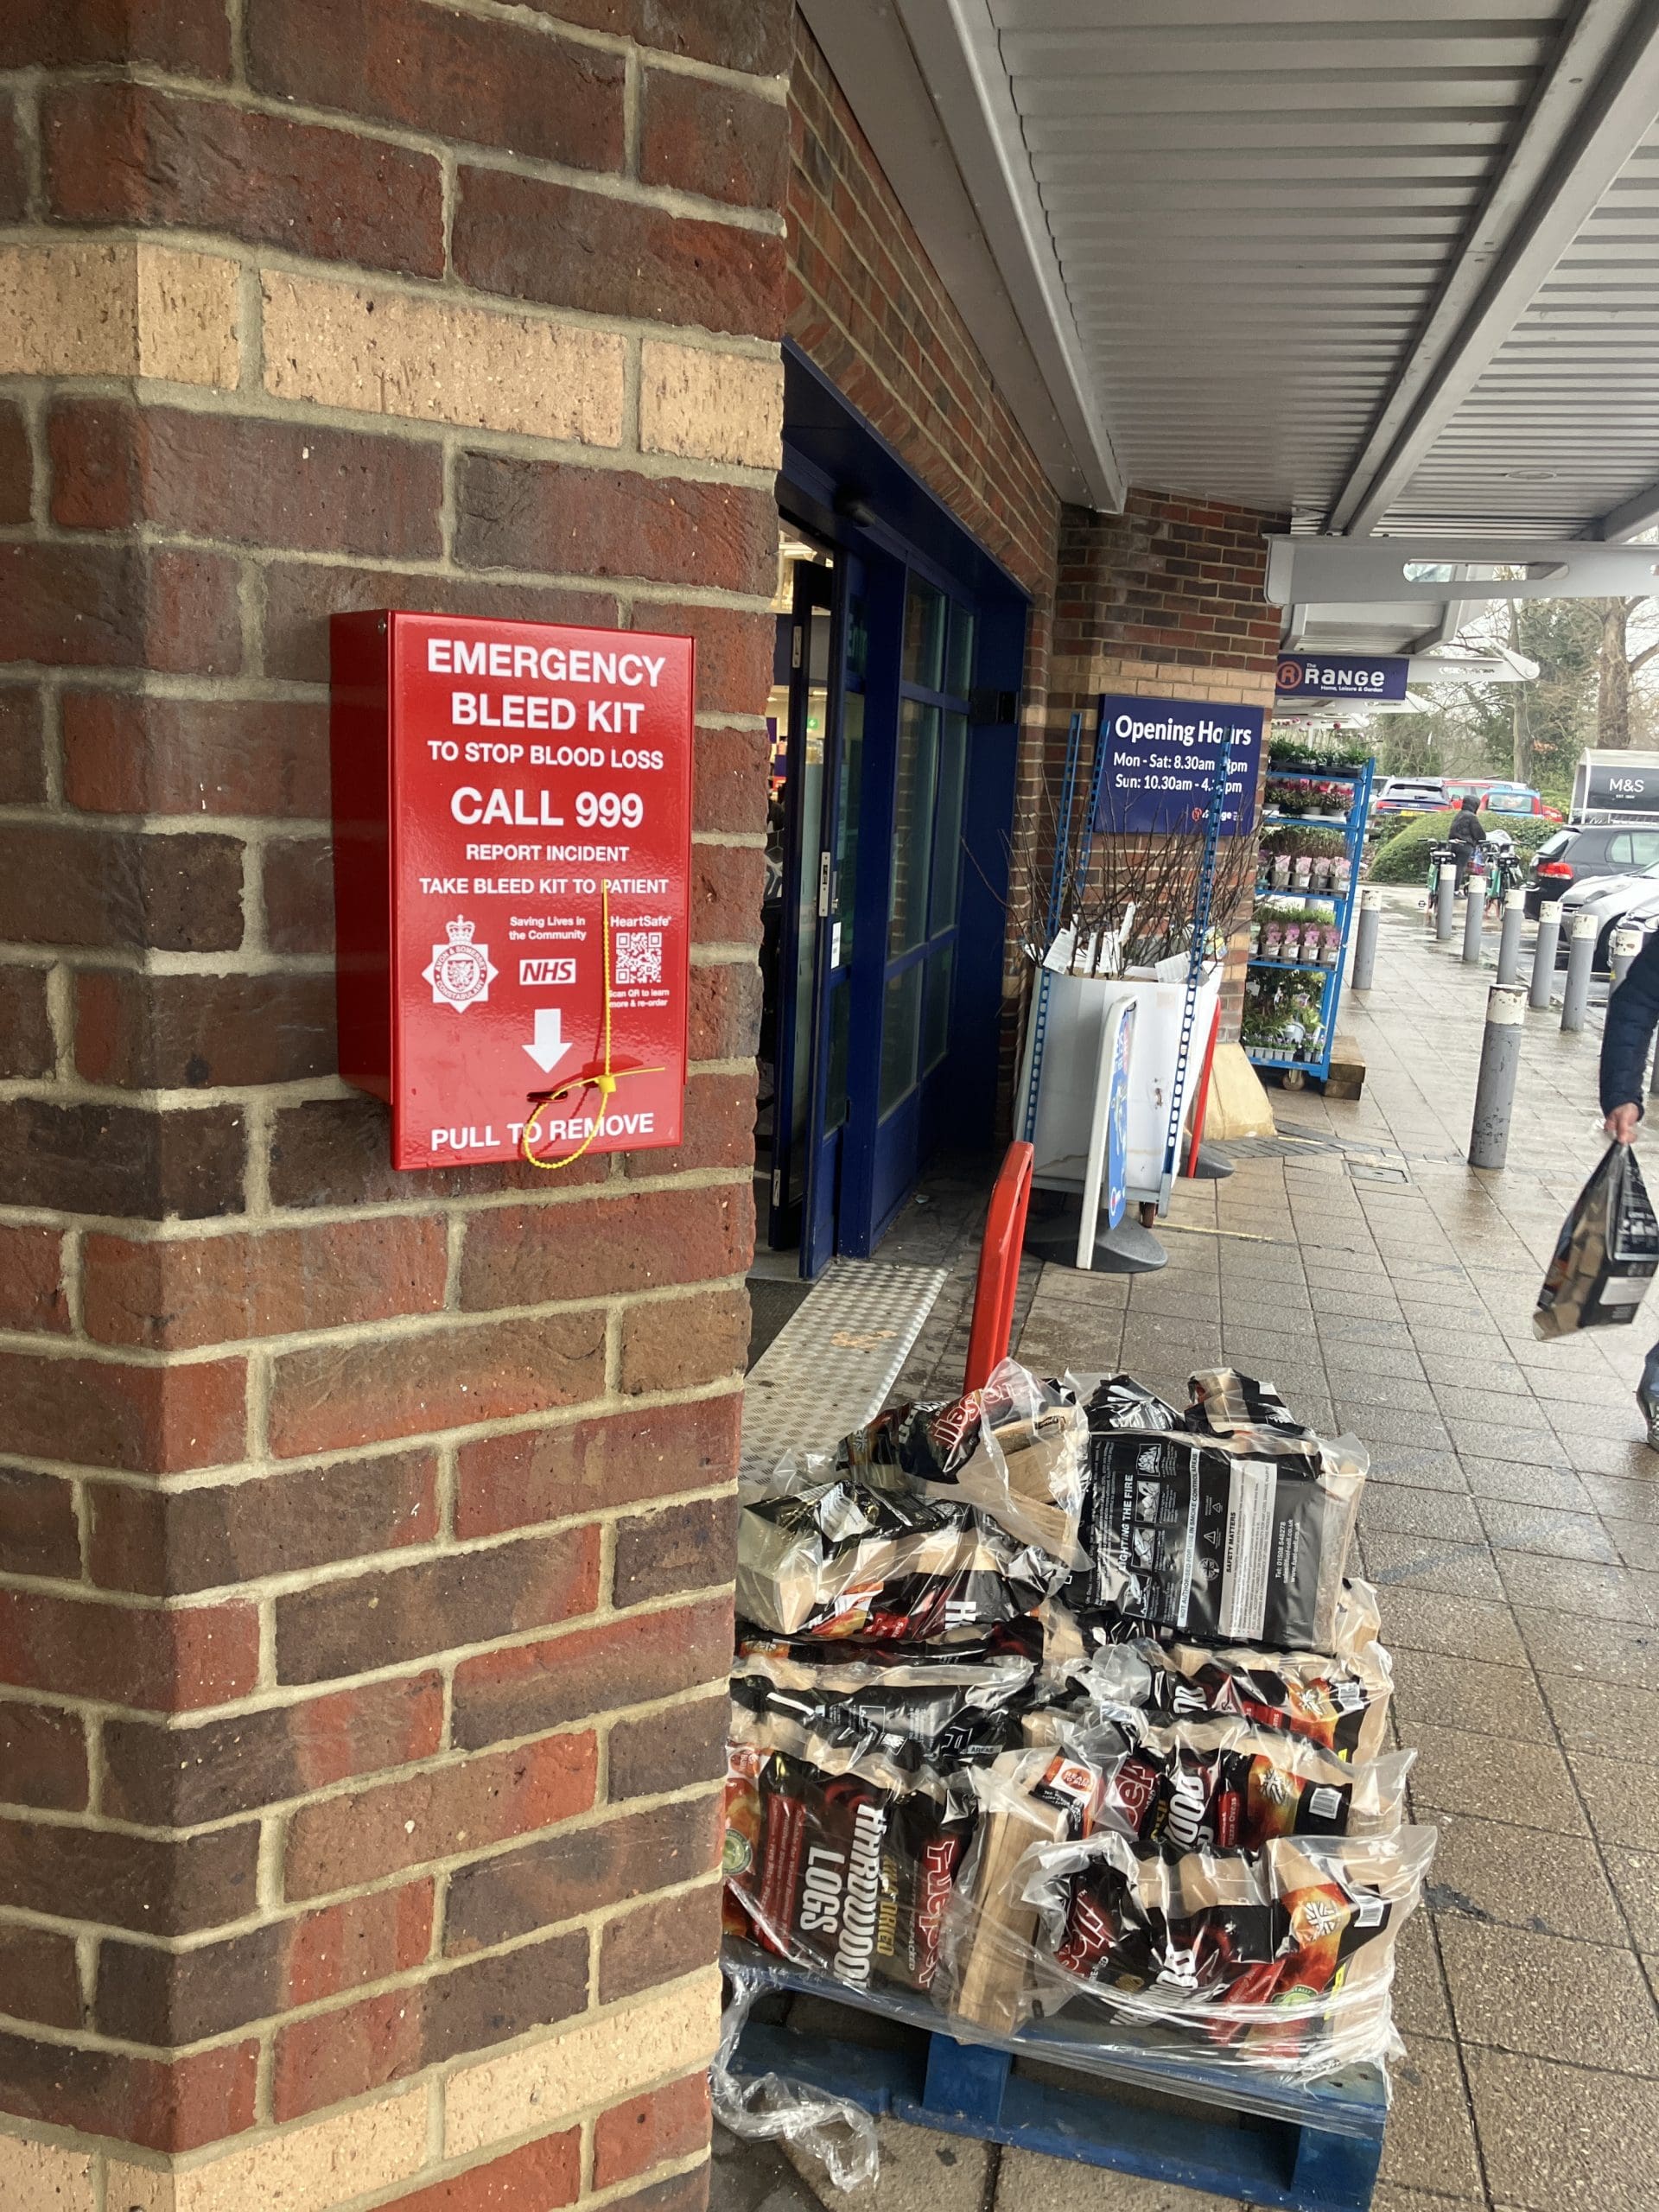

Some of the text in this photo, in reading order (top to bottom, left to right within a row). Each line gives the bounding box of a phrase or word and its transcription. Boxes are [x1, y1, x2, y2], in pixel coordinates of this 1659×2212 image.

[427, 638, 666, 688] EMERGENCY
[451, 691, 645, 734] BLEED KIT
[1115, 715, 1196, 747] Opening
[427, 740, 664, 770] TO STOP BLOOD LOSS
[1113, 751, 1141, 767] Mon
[1148, 753, 1172, 769] Sat:
[1173, 755, 1215, 771] 8.30am
[1115, 773, 1141, 789] Sun:
[1143, 775, 1192, 791] 10.30am
[1609, 778, 1644, 793] M&S
[449, 785, 645, 829] CALL 999
[465, 843, 631, 862] REPORT INCIDENT
[419, 878, 670, 894] TAKE BLEED KIT TO PATIENT
[510, 915, 586, 929] Saving Lives in
[508, 930, 588, 943] the Community
[435, 951, 450, 971] AVON
[522, 961, 573, 982] NHS
[641, 988, 650, 997] to
[651, 988, 671, 996] learn
[431, 1112, 655, 1152] PULL TO REMOVE
[1118, 1474, 1134, 1571] LIGHTING THE FIRE
[1182, 1564, 1191, 1604] AUTHORISED
[800, 1847, 845, 1934] LOGS
[876, 1902, 898, 1956] DRIED
